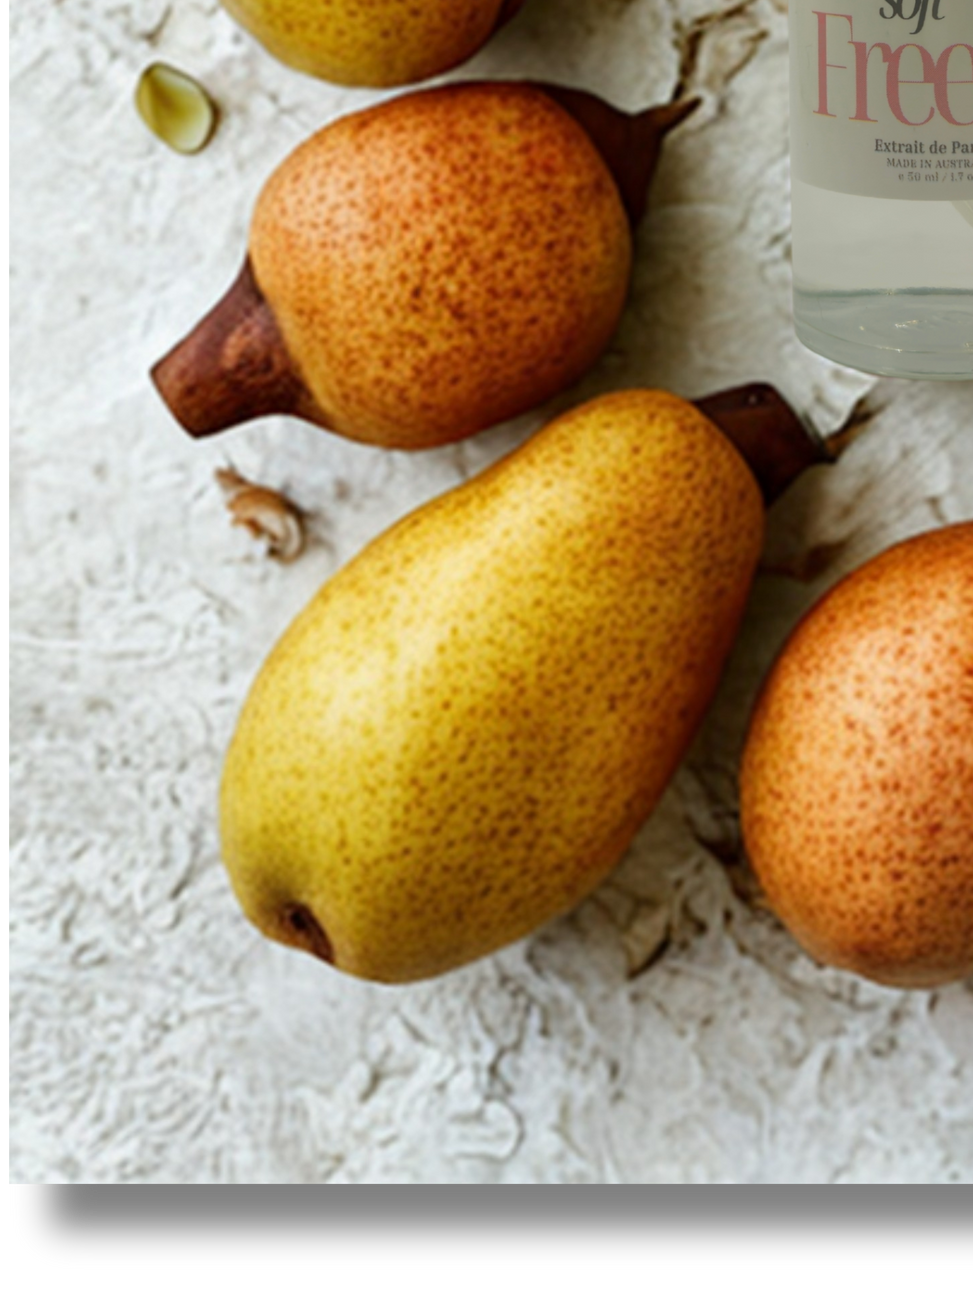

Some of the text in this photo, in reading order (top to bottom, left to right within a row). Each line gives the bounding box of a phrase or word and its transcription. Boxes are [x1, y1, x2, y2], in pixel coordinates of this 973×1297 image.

[875, 138, 925, 154] Extrait
[929, 140, 947, 154] de
[887, 158, 917, 169] MADE
[920, 159, 932, 169] IN
[907, 172, 921, 182] 50
[925, 171, 939, 182] ml
